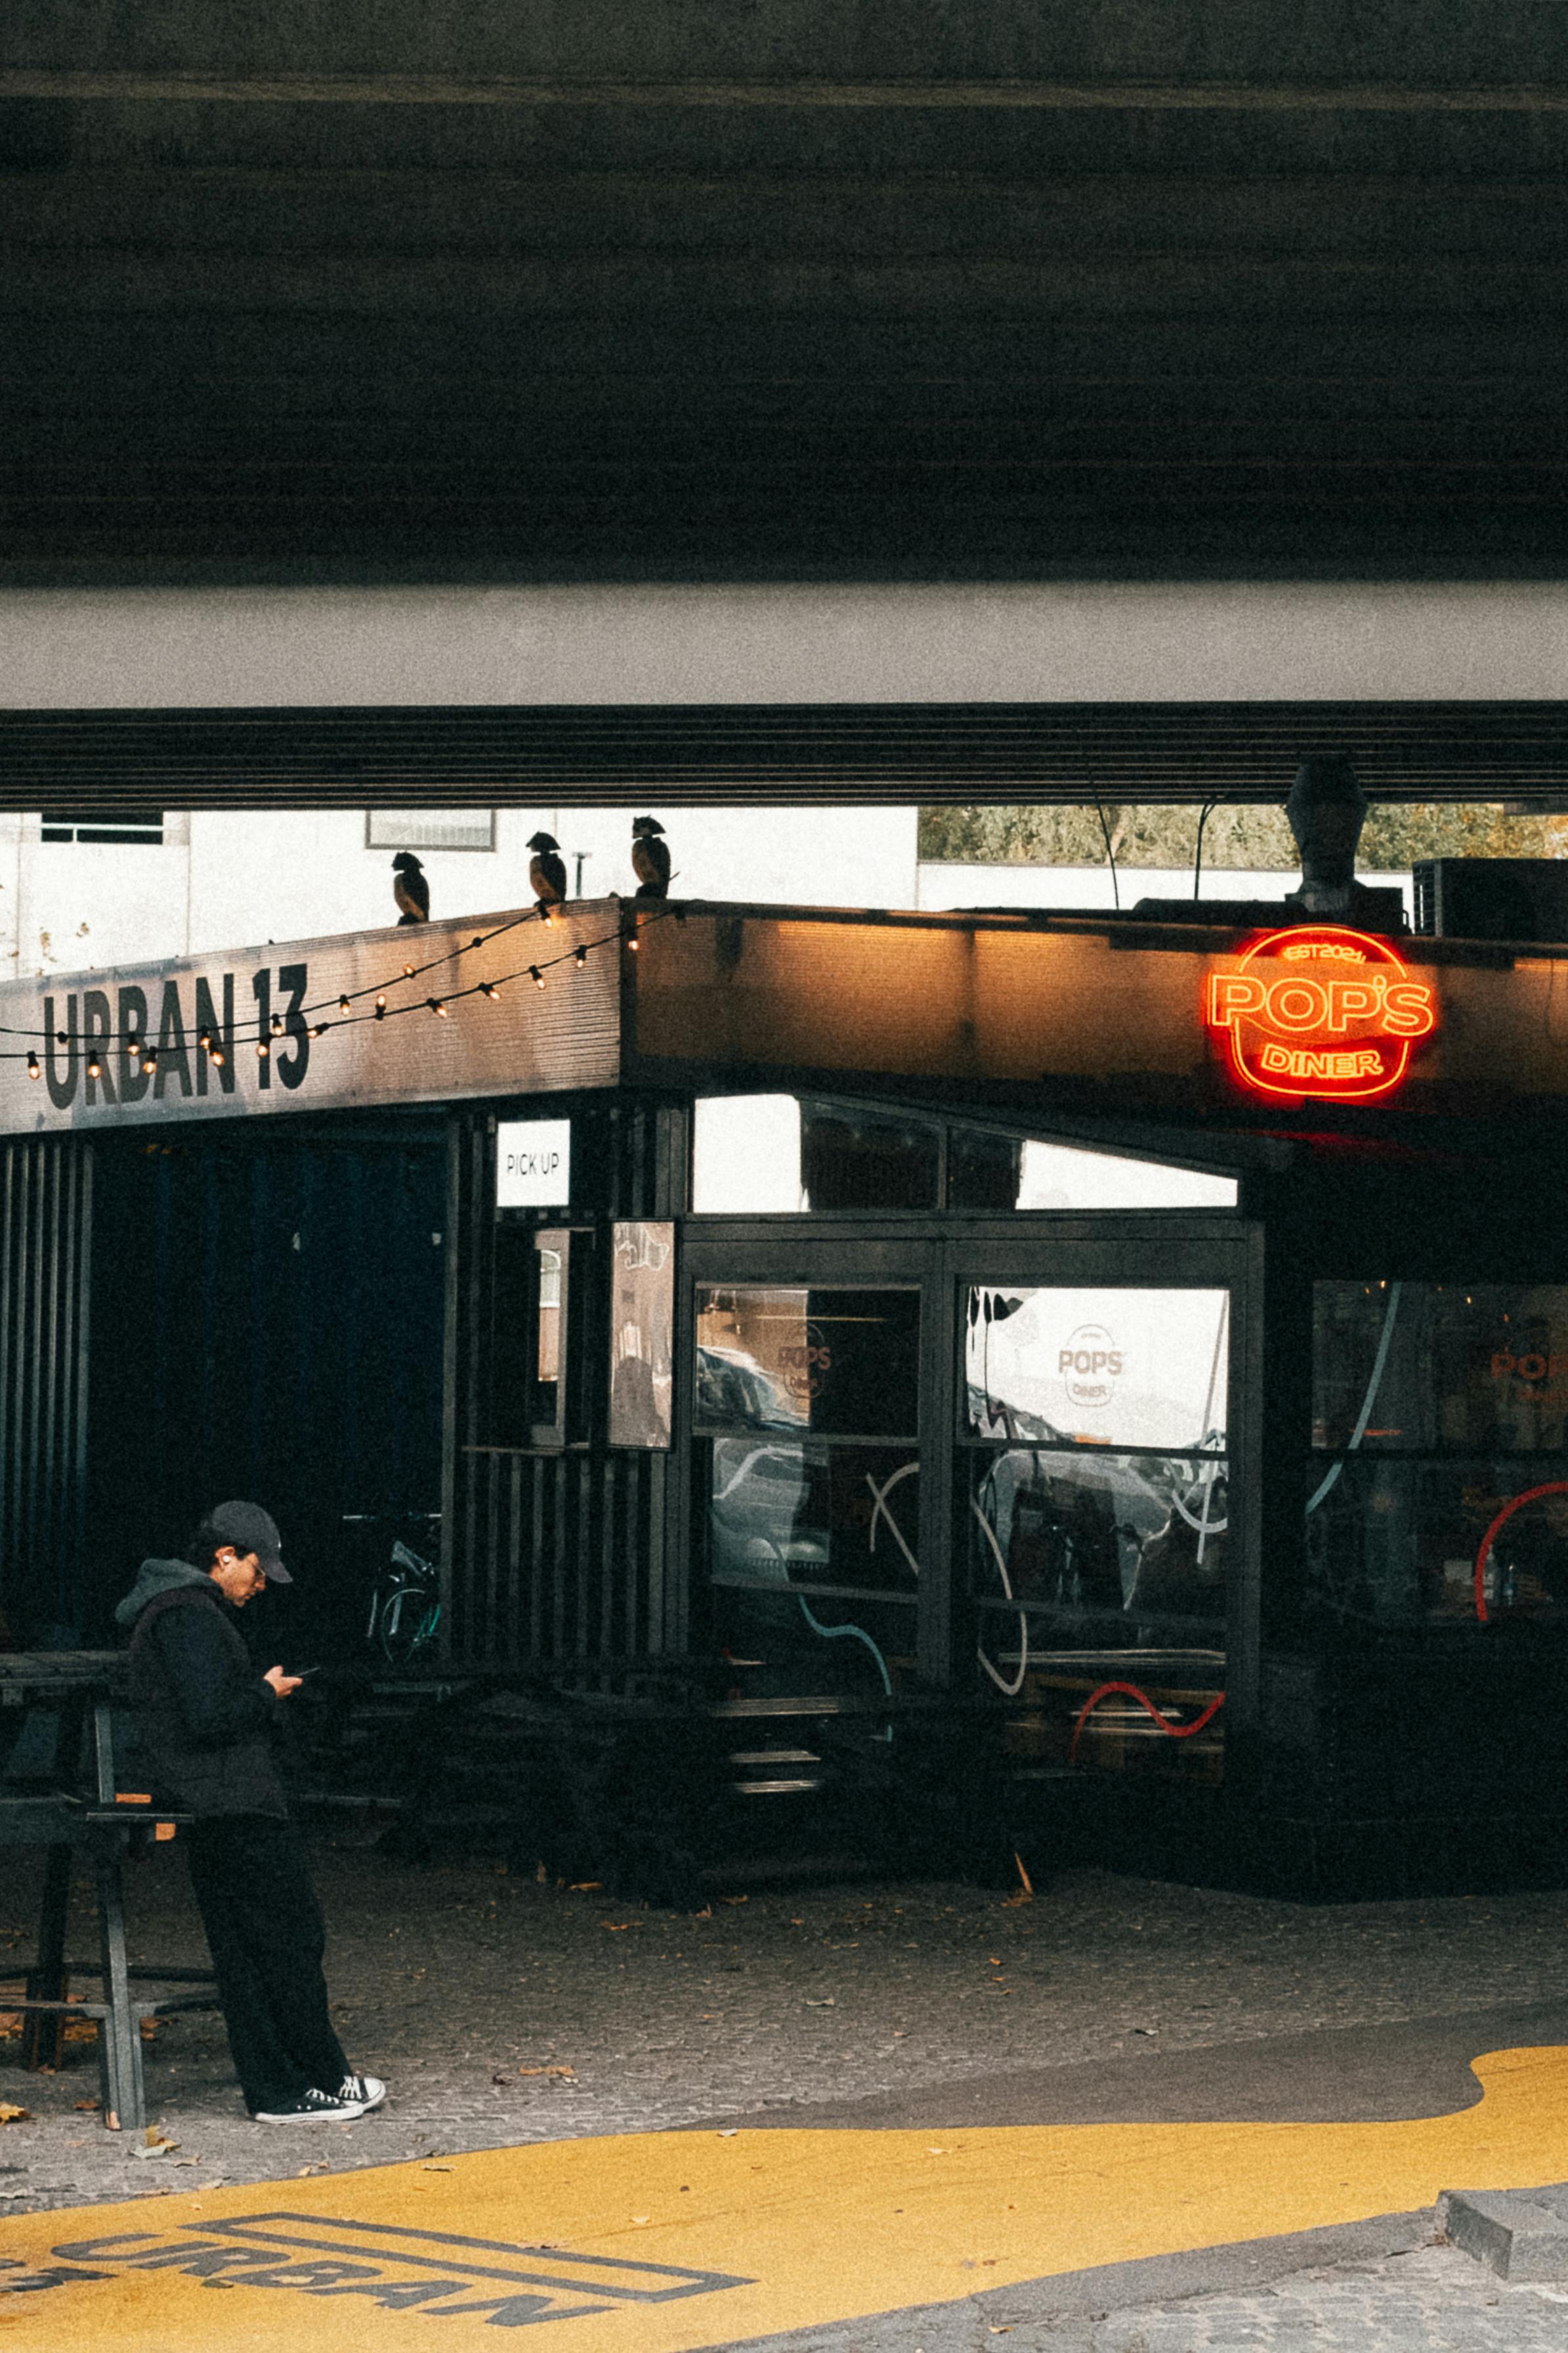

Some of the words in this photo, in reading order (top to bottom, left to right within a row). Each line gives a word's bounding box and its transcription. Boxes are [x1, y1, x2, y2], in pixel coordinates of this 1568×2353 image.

[1212, 974, 1433, 1037] POP'S
[43, 973, 235, 1110] URBAN
[252, 963, 310, 1090] 13
[1261, 1043, 1384, 1079] DINER
[507, 1154, 536, 1175] PICK
[541, 1152, 559, 1175] UP
[1058, 1350, 1123, 1376] POPS
[49, 2234, 620, 2327] URBAN
